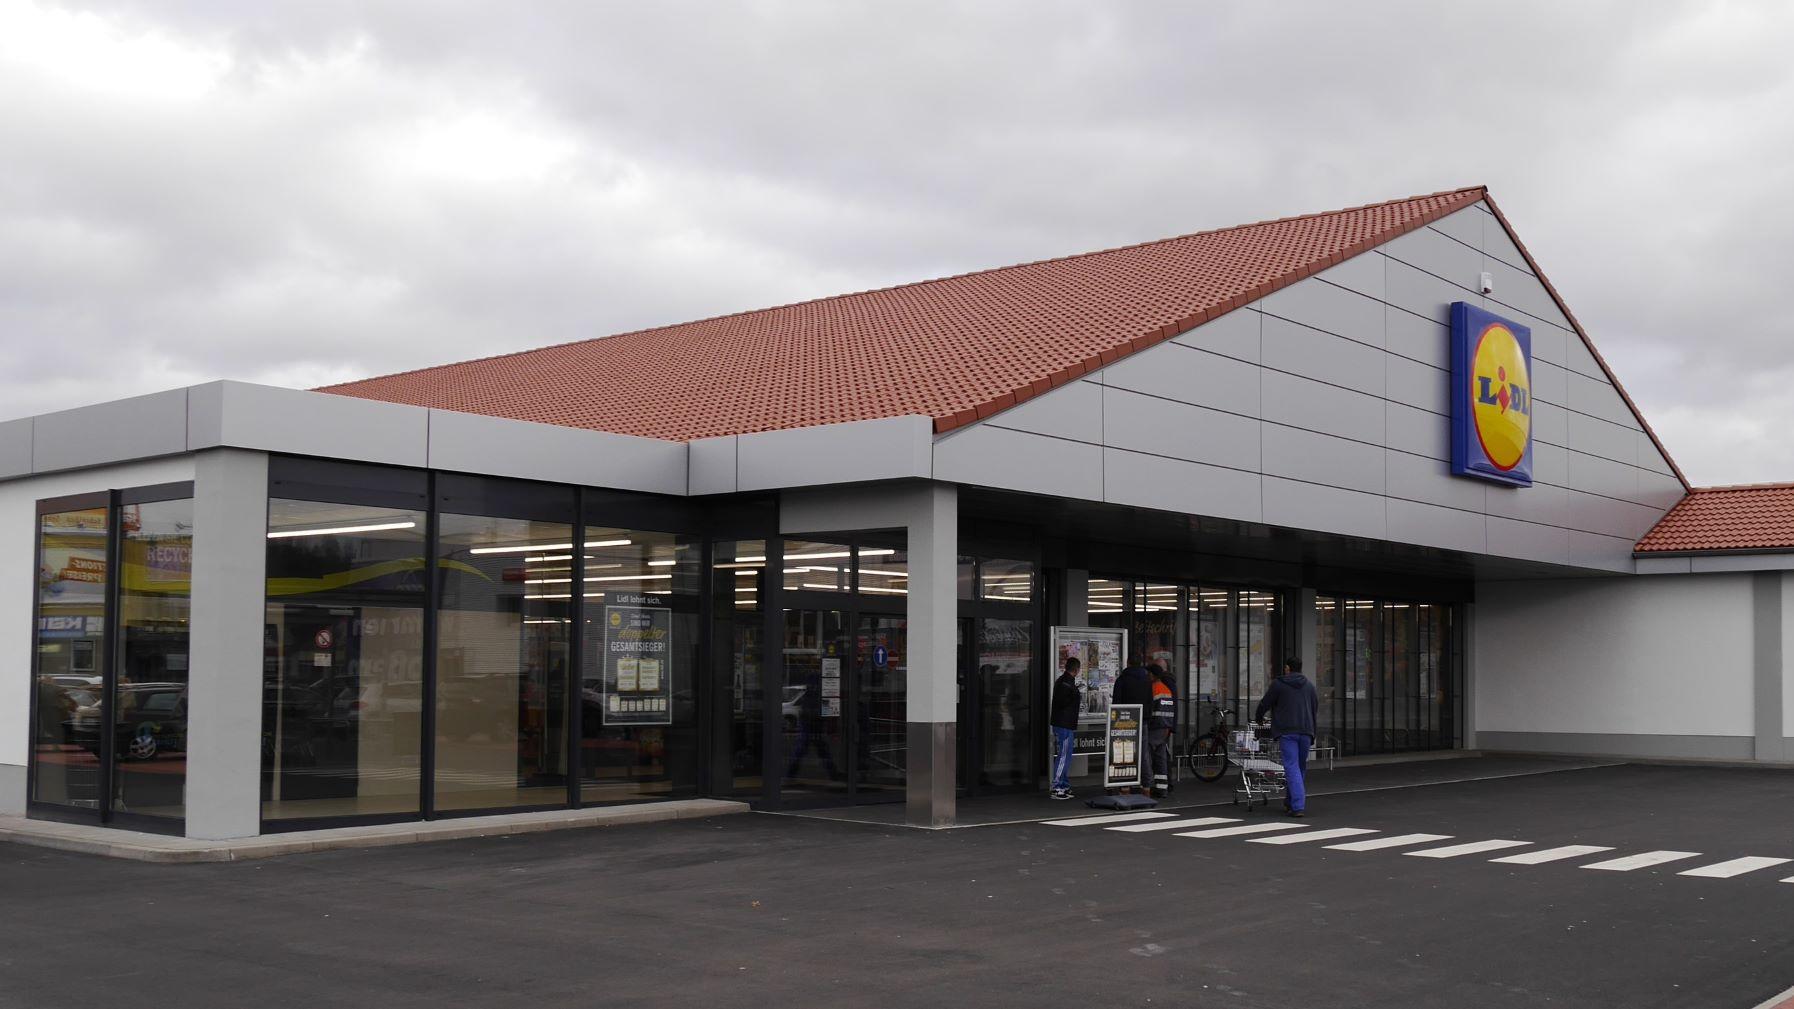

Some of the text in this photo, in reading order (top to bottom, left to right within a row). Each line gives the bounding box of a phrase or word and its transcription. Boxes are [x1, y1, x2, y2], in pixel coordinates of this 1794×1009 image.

[616, 594, 661, 605] Lidl lohnt sich.
[610, 641, 666, 652] GESAMTSIEGER!
[1079, 736, 1095, 748] lohnt
[1097, 736, 1106, 748] sic
